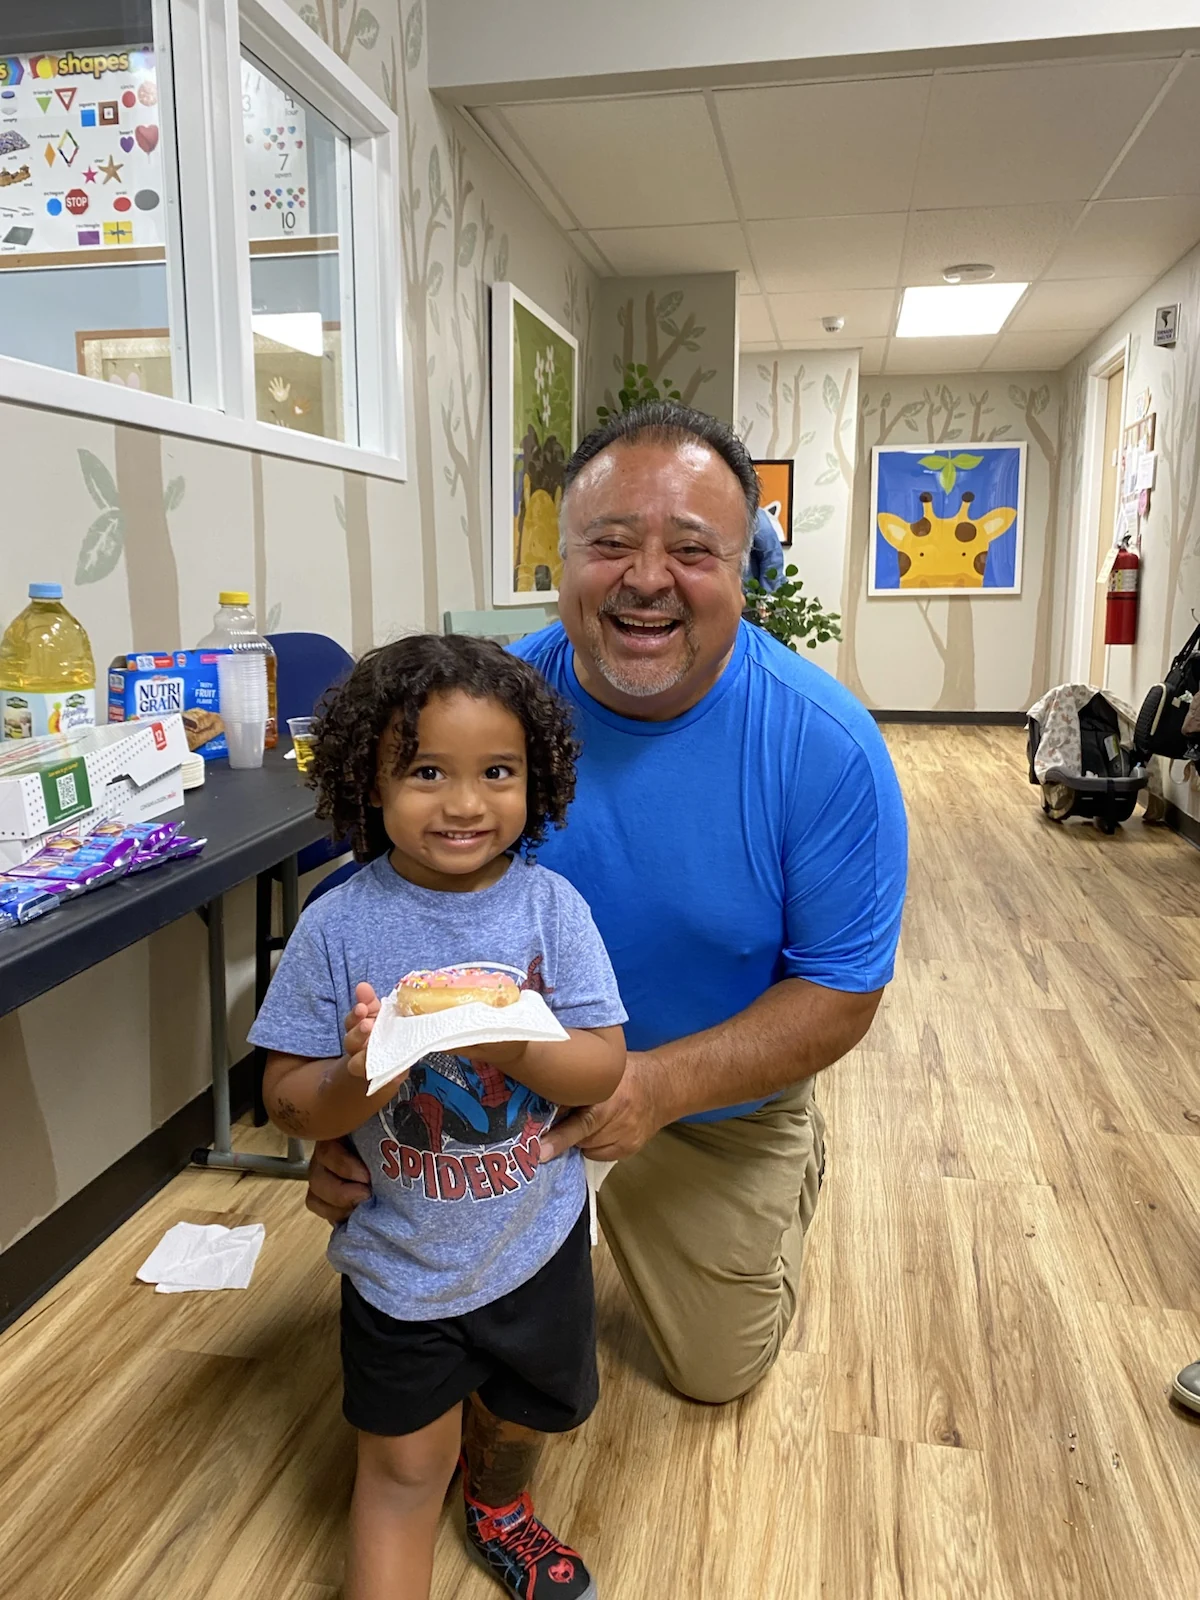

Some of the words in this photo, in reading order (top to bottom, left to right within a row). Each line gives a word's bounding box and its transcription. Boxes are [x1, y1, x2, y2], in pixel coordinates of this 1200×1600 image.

[58, 51, 129, 79] shapes
[278, 153, 289, 171] 7
[66, 197, 87, 207] STOP
[281, 211, 296, 229] 10
[139, 682, 180, 701] NUTRI
[195, 688, 216, 698] FRUIT
[139, 695, 181, 713] GRAIN
[155, 729, 163, 741] 12
[379, 1135, 541, 1203] SPIDER-M
